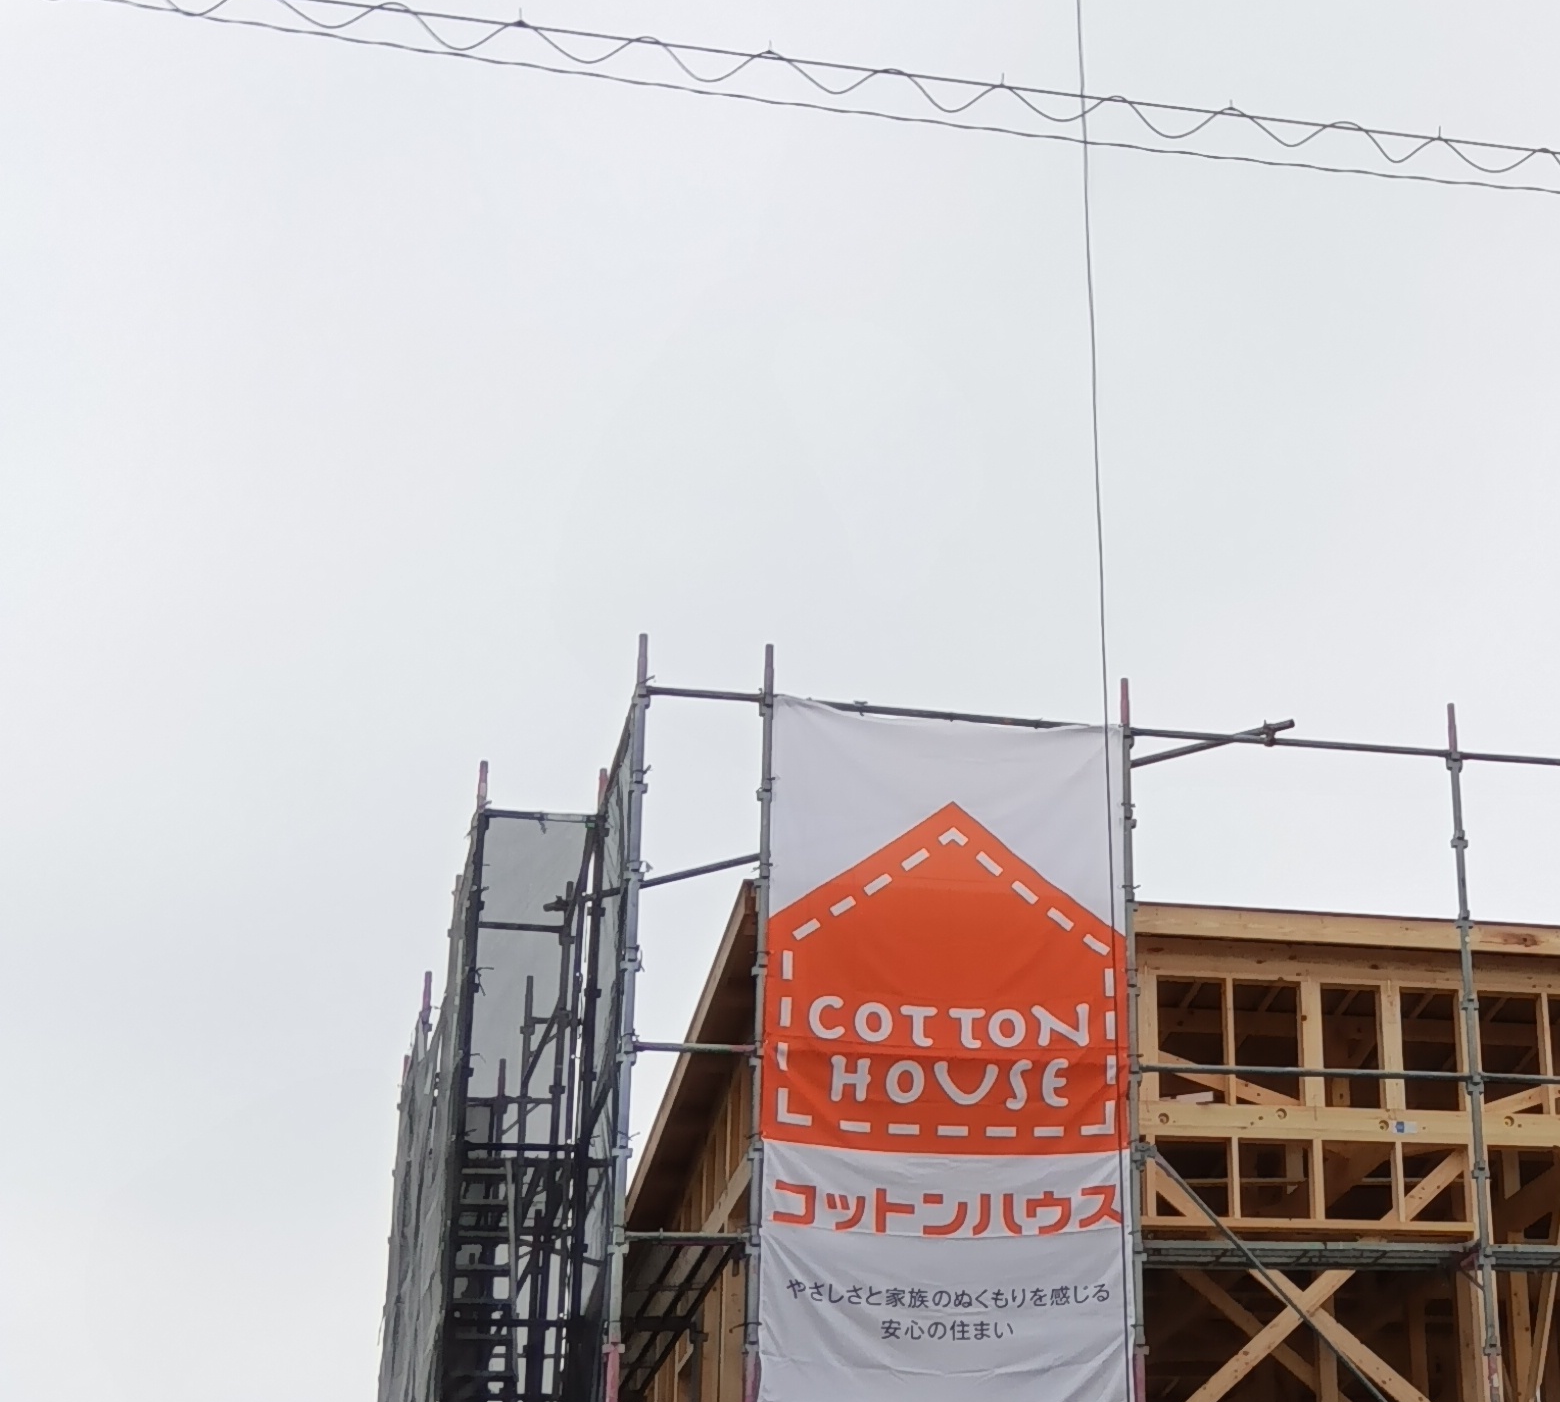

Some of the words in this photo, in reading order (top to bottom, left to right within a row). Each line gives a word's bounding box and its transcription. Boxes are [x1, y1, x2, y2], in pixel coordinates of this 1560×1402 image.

[808, 995, 1091, 1049] COTTON
[829, 1056, 1070, 1111] HOUSE
[772, 1179, 1124, 1237] コットンハウス
[786, 1279, 1110, 1310] やさしさと家族のぬくもりを感じる
[880, 1320, 1014, 1342] 安心の住まい
